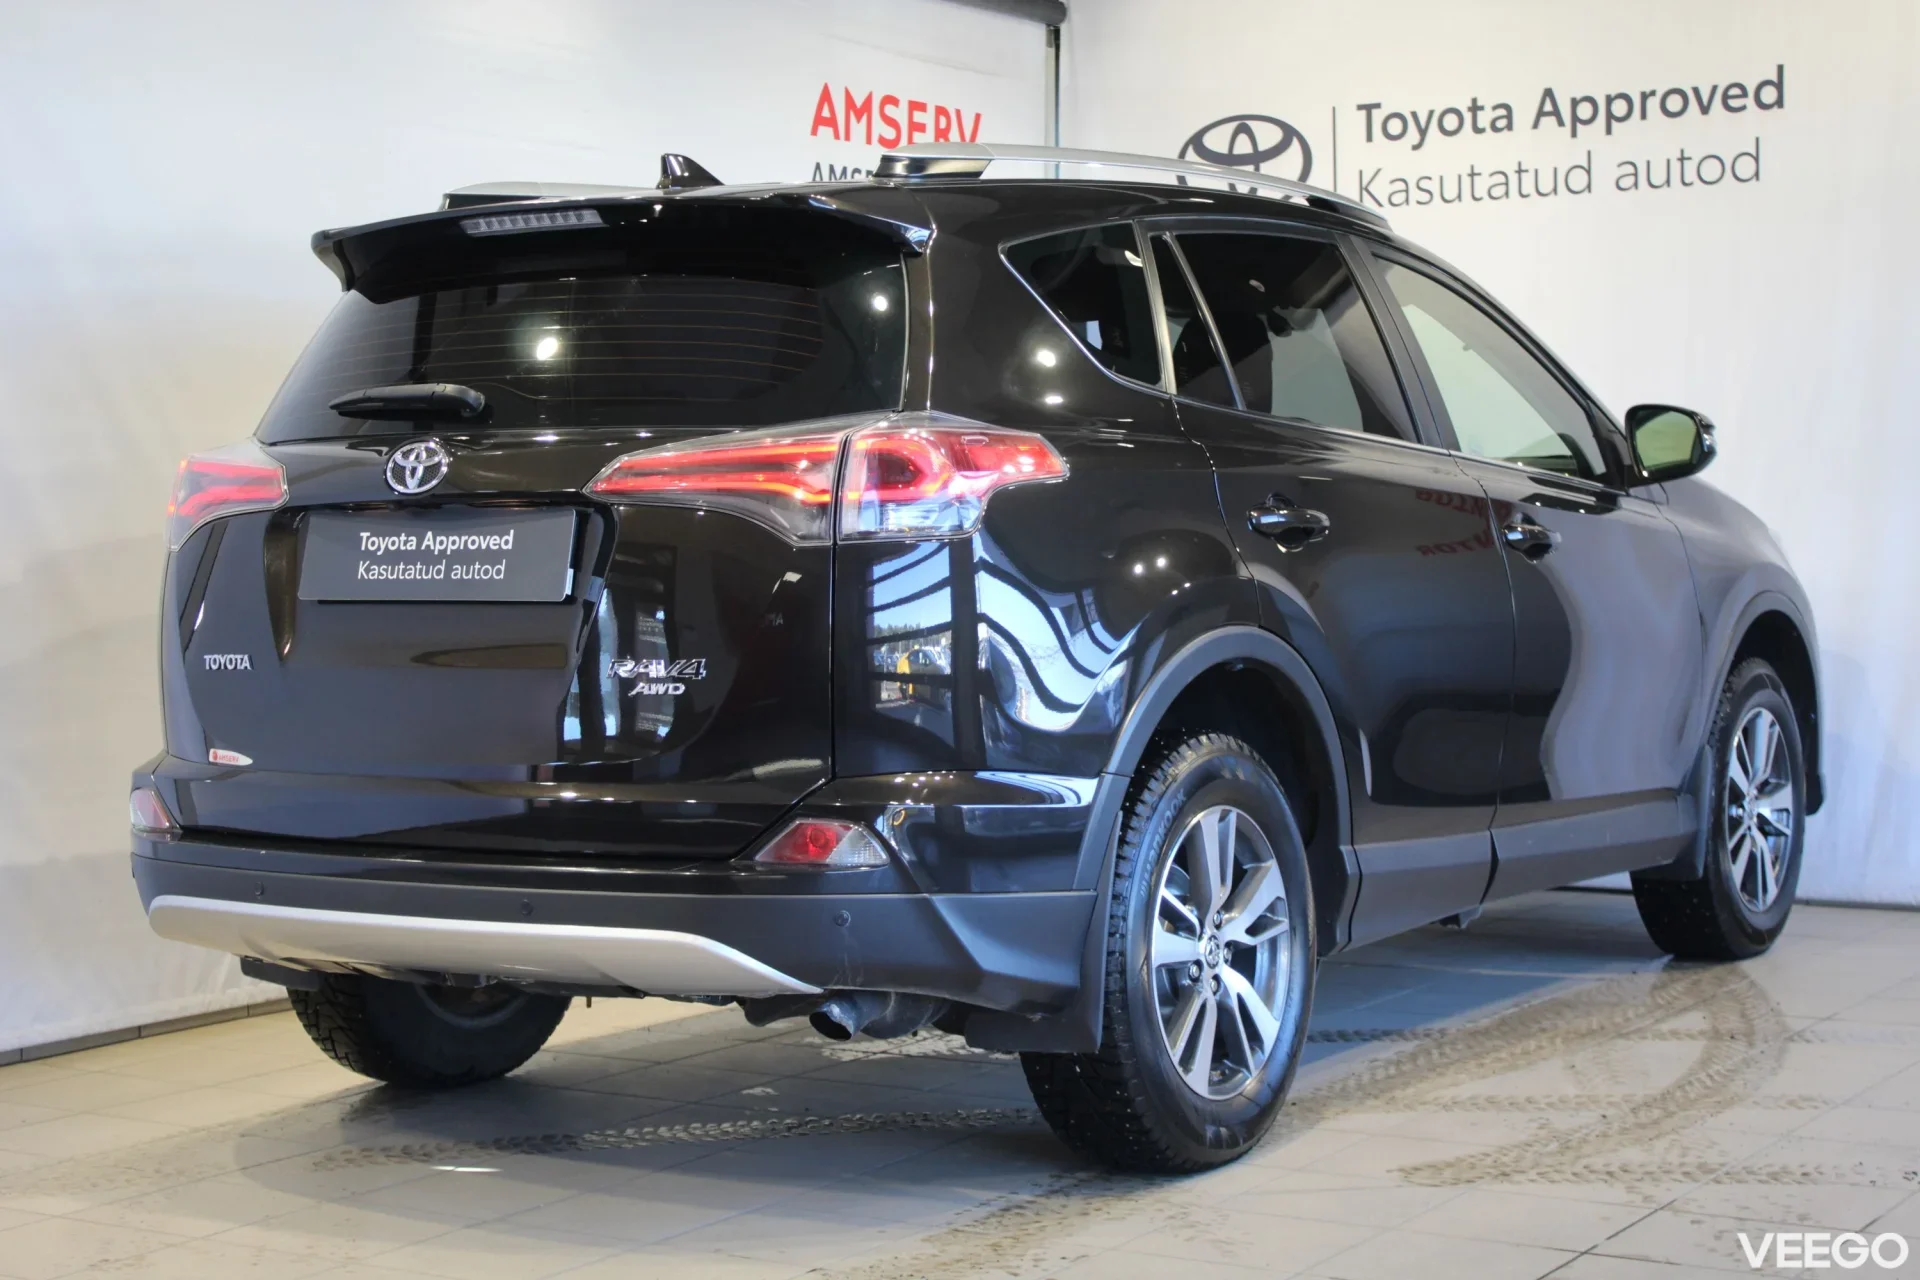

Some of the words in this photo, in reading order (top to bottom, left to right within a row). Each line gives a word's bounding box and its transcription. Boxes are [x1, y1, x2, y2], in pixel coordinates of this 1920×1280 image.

[810, 82, 982, 149] AMSERV
[1356, 96, 1515, 151] Toyota
[1531, 64, 1786, 138] Approved
[1358, 150, 1593, 208] Kasutatud
[1614, 137, 1761, 192] autod
[359, 531, 417, 555] Toyota
[420, 529, 515, 555] Approved
[357, 559, 446, 580] Kasutatud
[450, 559, 506, 580] autod
[203, 653, 252, 671] TOYOTA
[606, 657, 707, 680] RAV4
[628, 682, 686, 697] AWD
